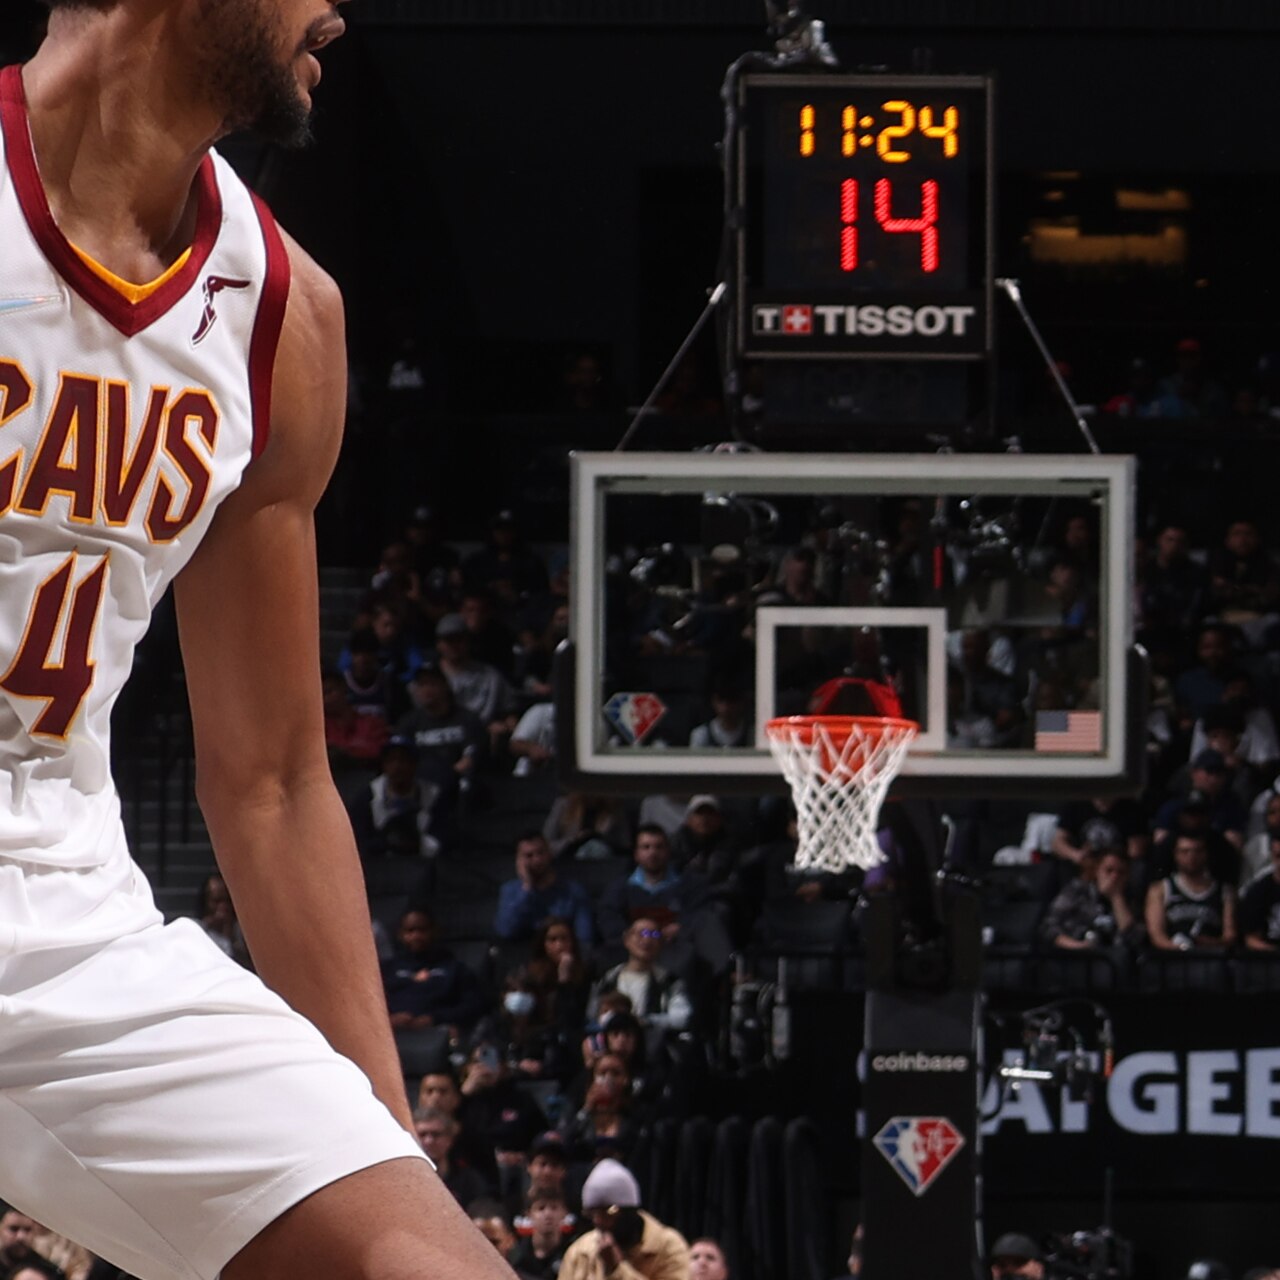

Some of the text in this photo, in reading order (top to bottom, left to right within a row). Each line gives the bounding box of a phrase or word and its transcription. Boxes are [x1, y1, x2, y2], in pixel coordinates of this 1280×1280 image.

[800, 101, 959, 162] 11:24
[840, 178, 940, 272] 14
[815, 306, 975, 336] TISSOT
[0, 546, 110, 742] 4
[872, 1052, 970, 1073] coinbase
